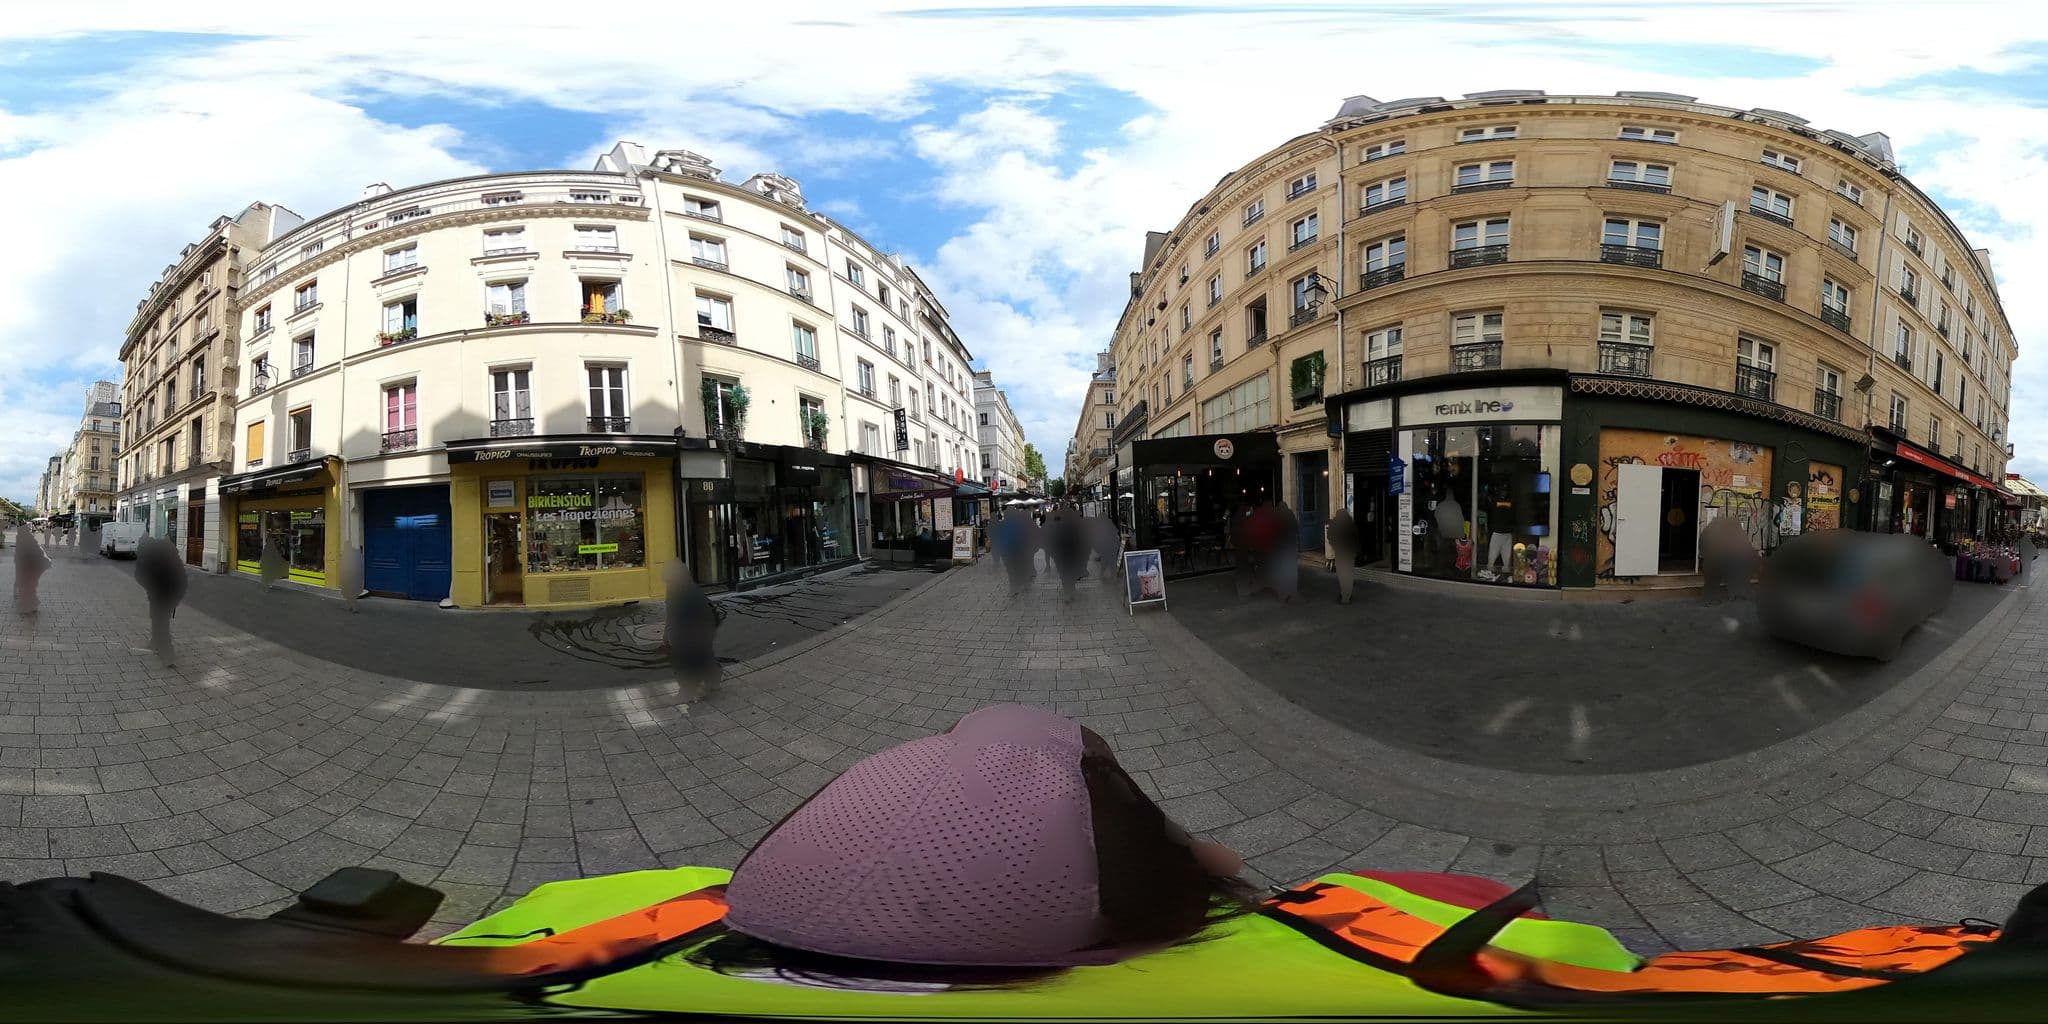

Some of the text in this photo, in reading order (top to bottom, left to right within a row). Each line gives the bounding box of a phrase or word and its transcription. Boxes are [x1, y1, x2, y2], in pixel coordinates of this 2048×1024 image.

[1435, 400, 1501, 416] remix line
[474, 450, 511, 461] TROPICO
[579, 445, 617, 456] TROPICO
[702, 481, 714, 491] 80
[527, 495, 592, 509] BIRKENSTOCK
